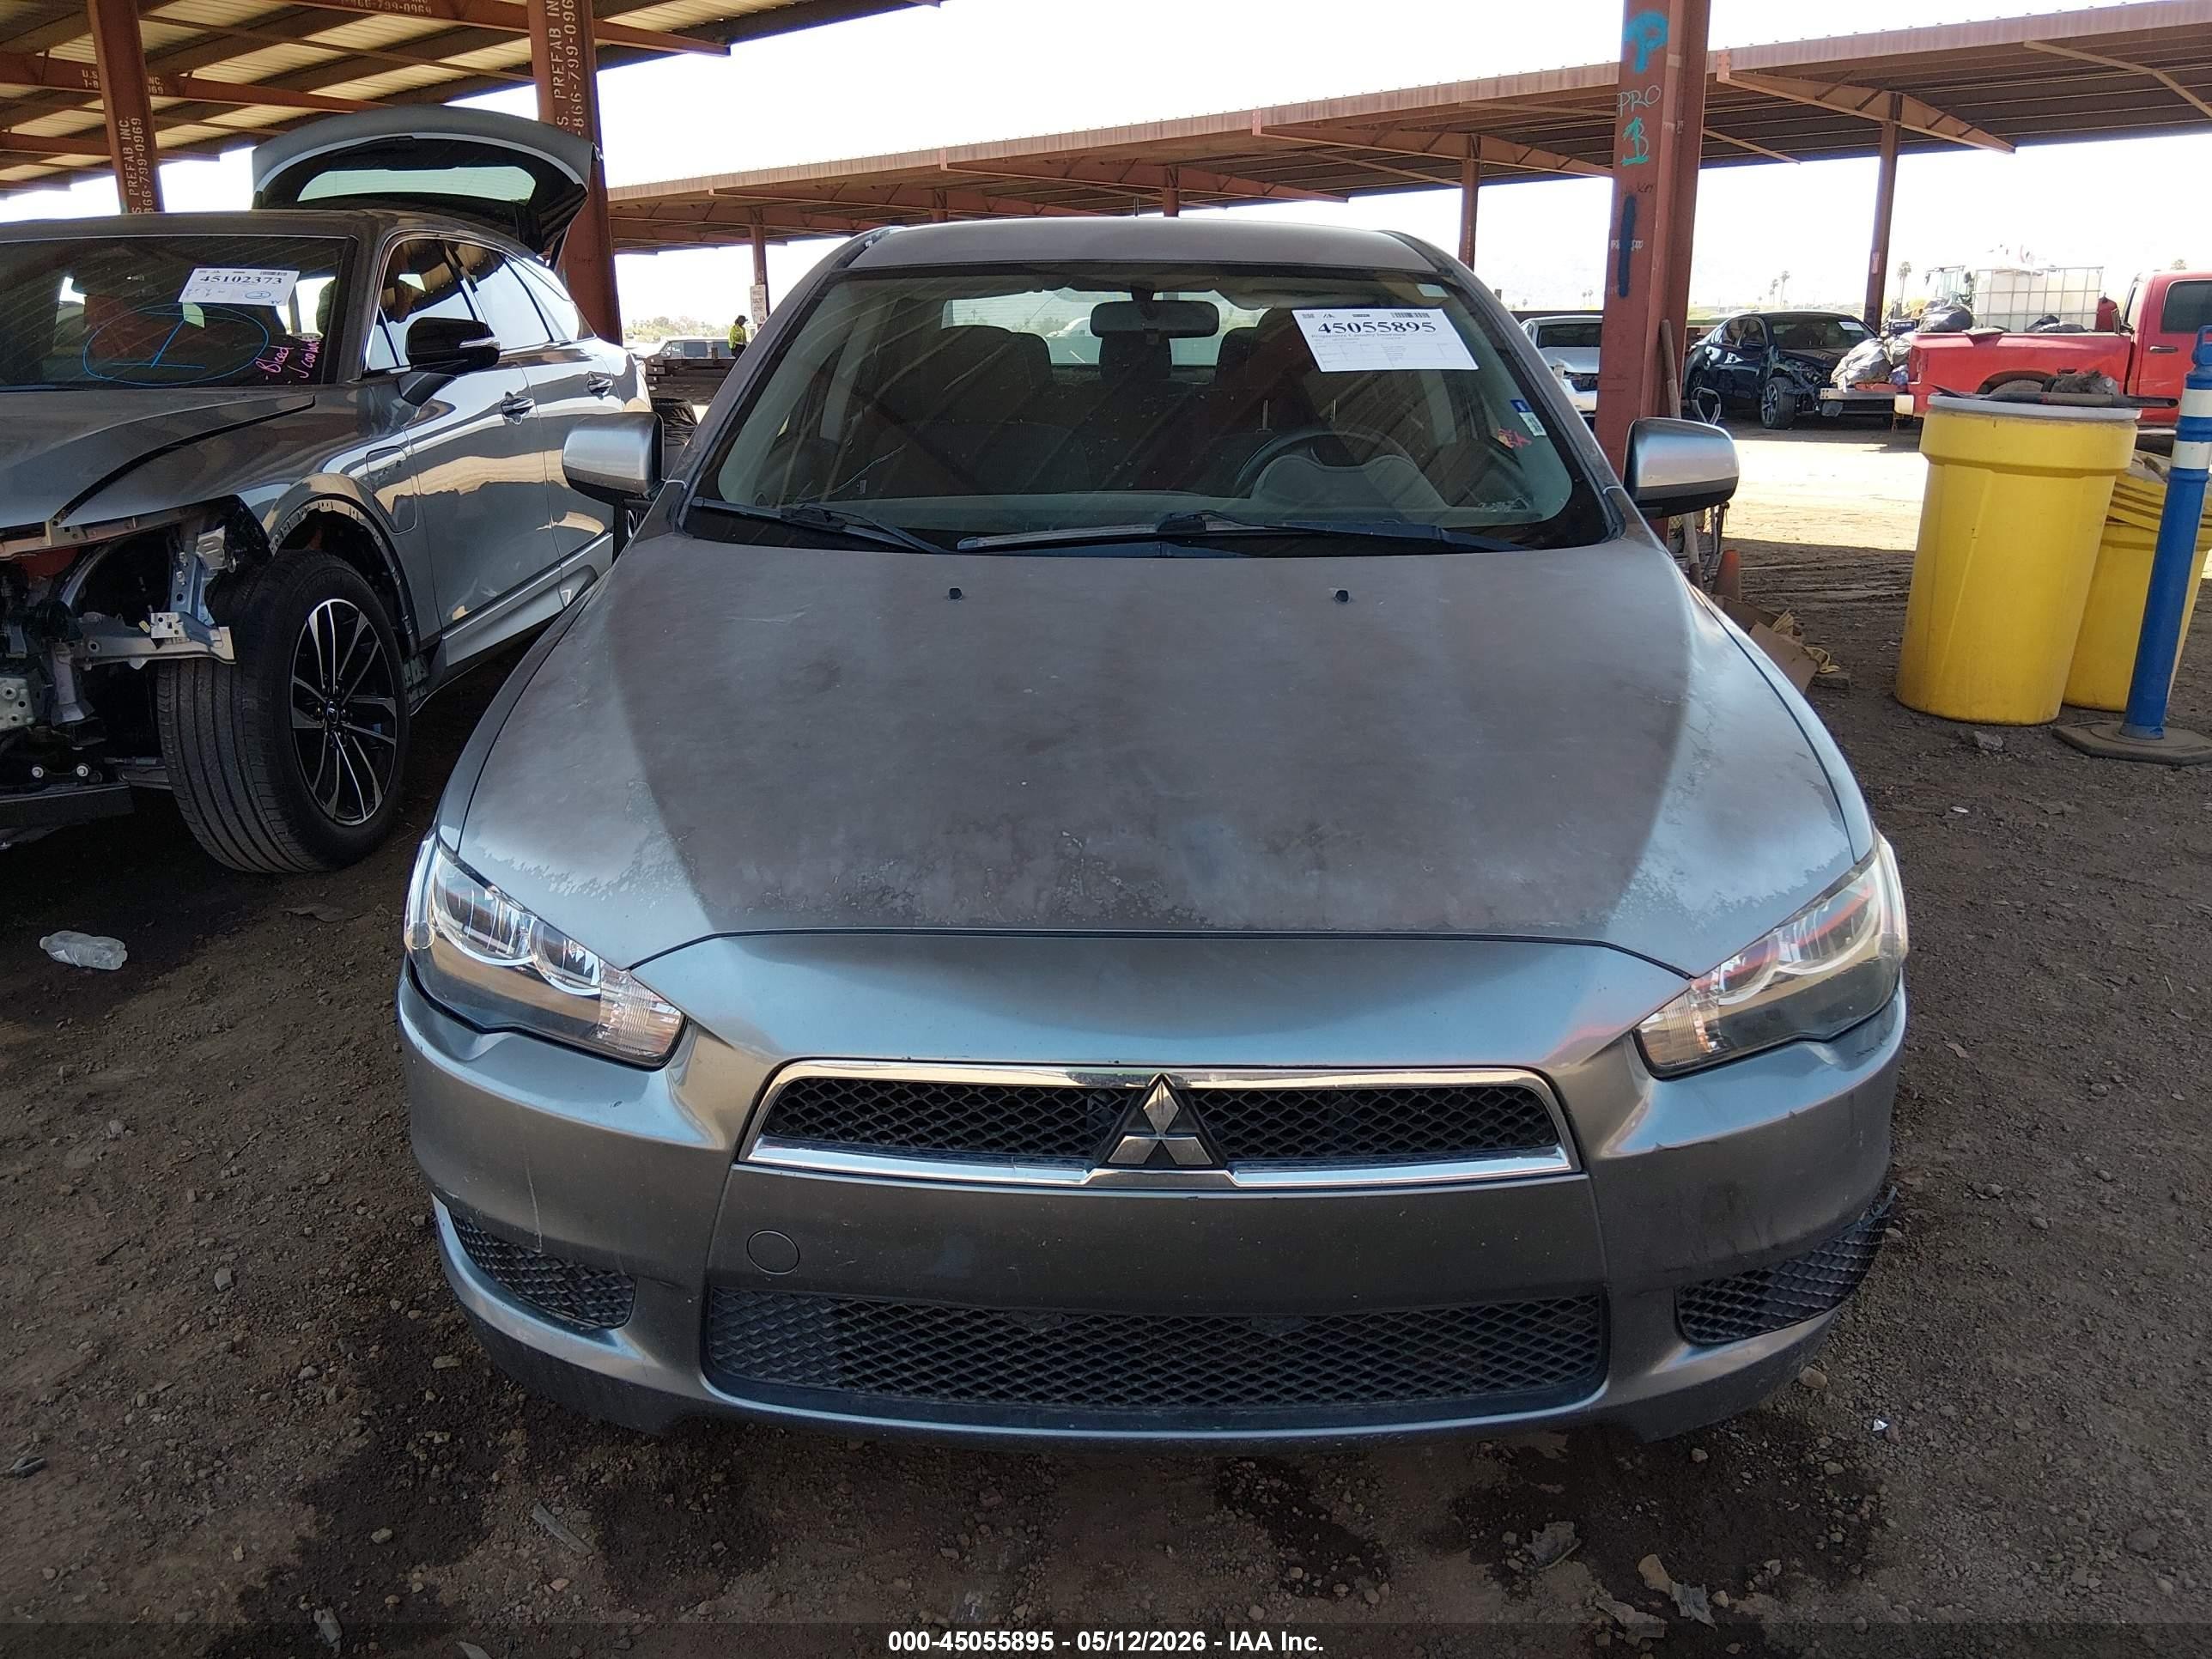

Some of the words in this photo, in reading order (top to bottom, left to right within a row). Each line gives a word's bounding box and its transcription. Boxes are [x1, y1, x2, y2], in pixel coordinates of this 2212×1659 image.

[546, 0, 560, 17] IN
[549, 27, 568, 100] PREFAB
[562, 0, 586, 137] -866-799-096
[1618, 85, 1662, 118] PRO
[118, 116, 131, 141] INC.
[124, 146, 140, 197] PREFAB
[131, 117, 155, 214] 866-799-0969
[199, 275, 283, 285] 45102373
[1318, 321, 1437, 334] 45055895
